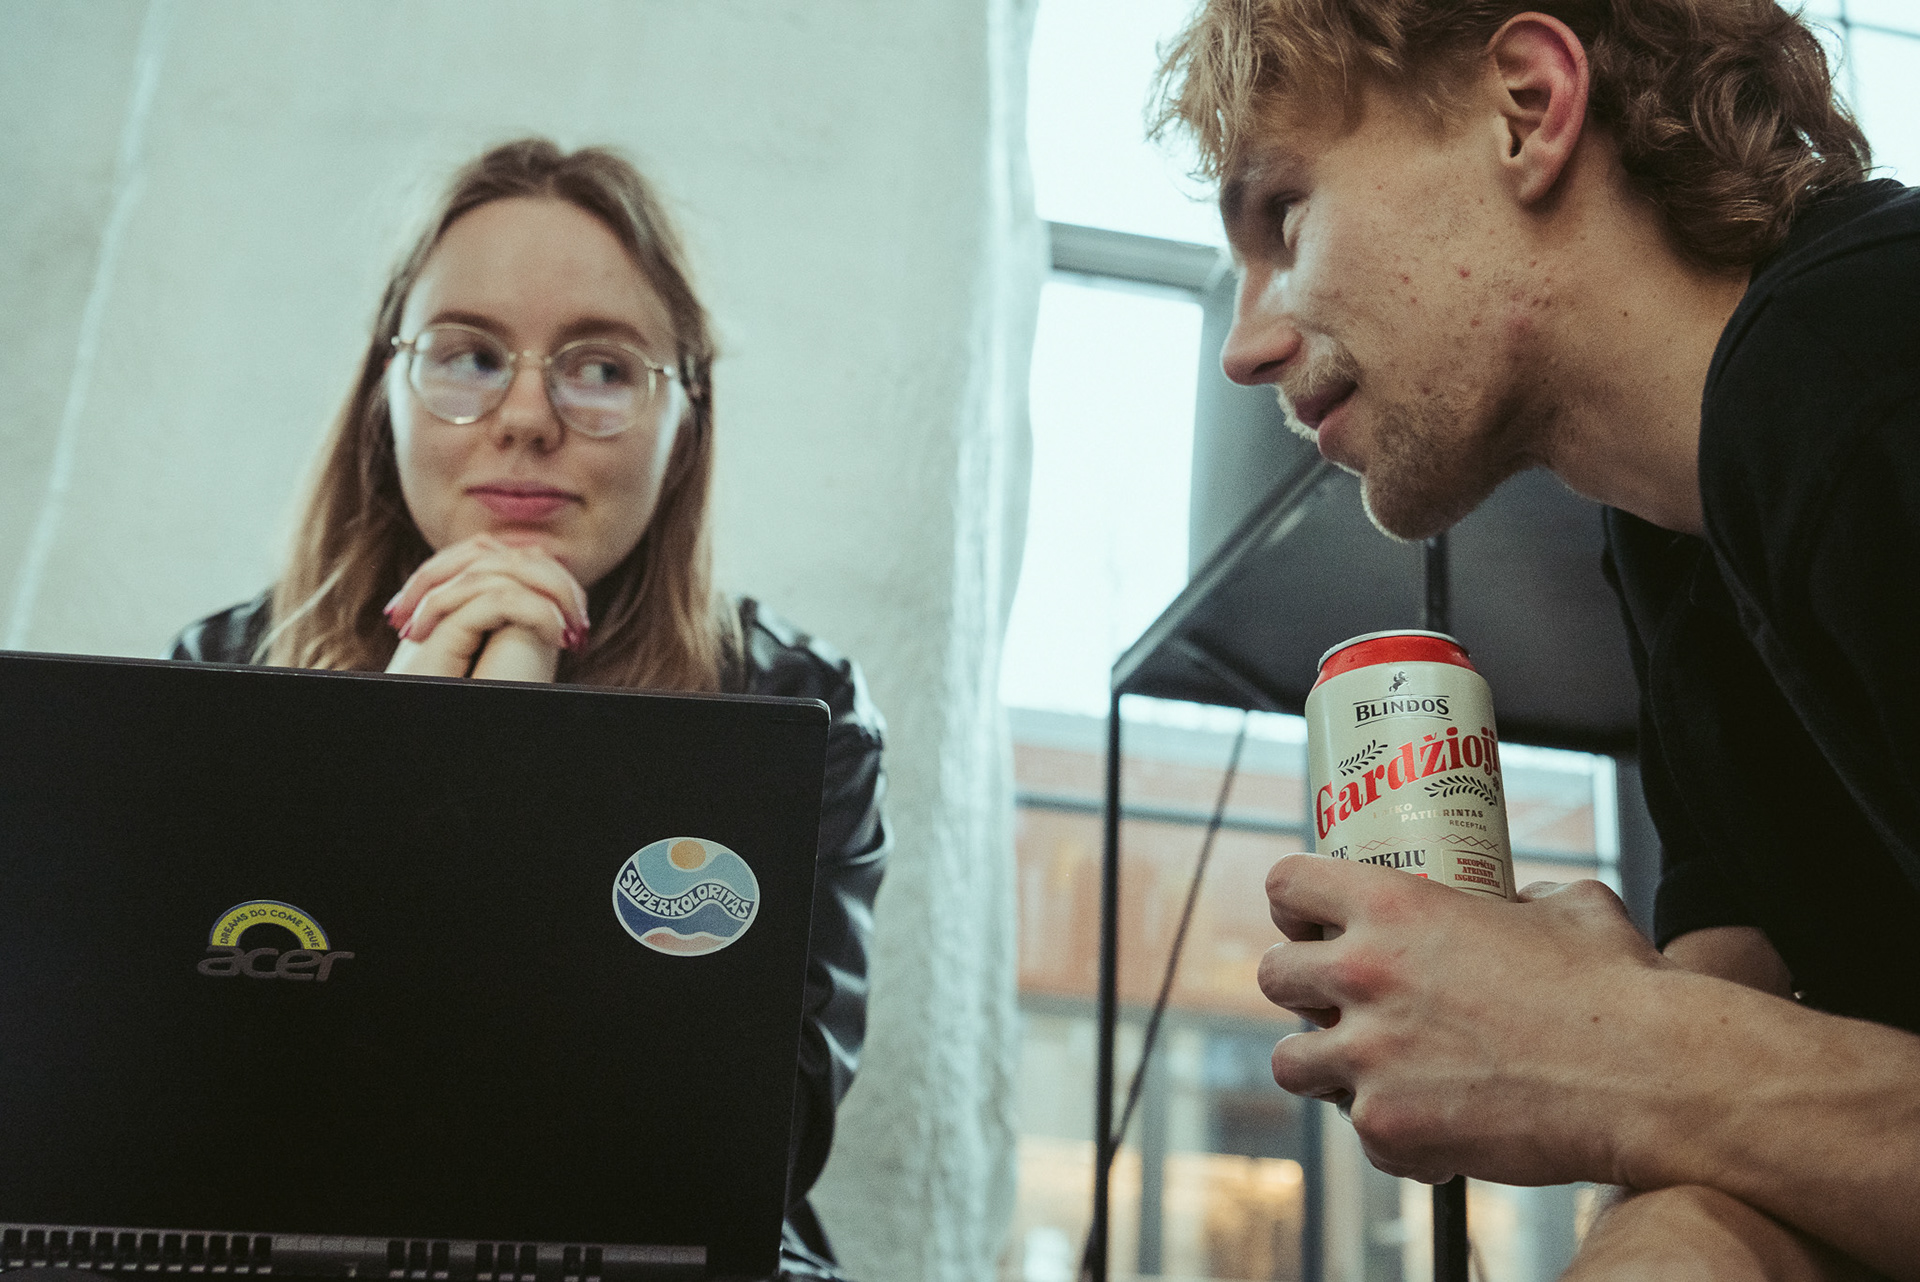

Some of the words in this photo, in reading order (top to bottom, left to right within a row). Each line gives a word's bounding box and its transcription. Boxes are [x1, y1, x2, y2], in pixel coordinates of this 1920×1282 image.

[1355, 699, 1449, 722] BLINDOS
[1373, 803, 1413, 819] IKO
[1449, 819, 1488, 832] RECEPTAS
[1358, 849, 1426, 868] IKLIŲ
[621, 869, 751, 919] SUPERKOLORITAS
[220, 913, 248, 945] DREAMS
[249, 909, 267, 918] DO
[270, 909, 302, 927] COME
[302, 925, 320, 948] TRUE
[197, 945, 355, 982] acer
